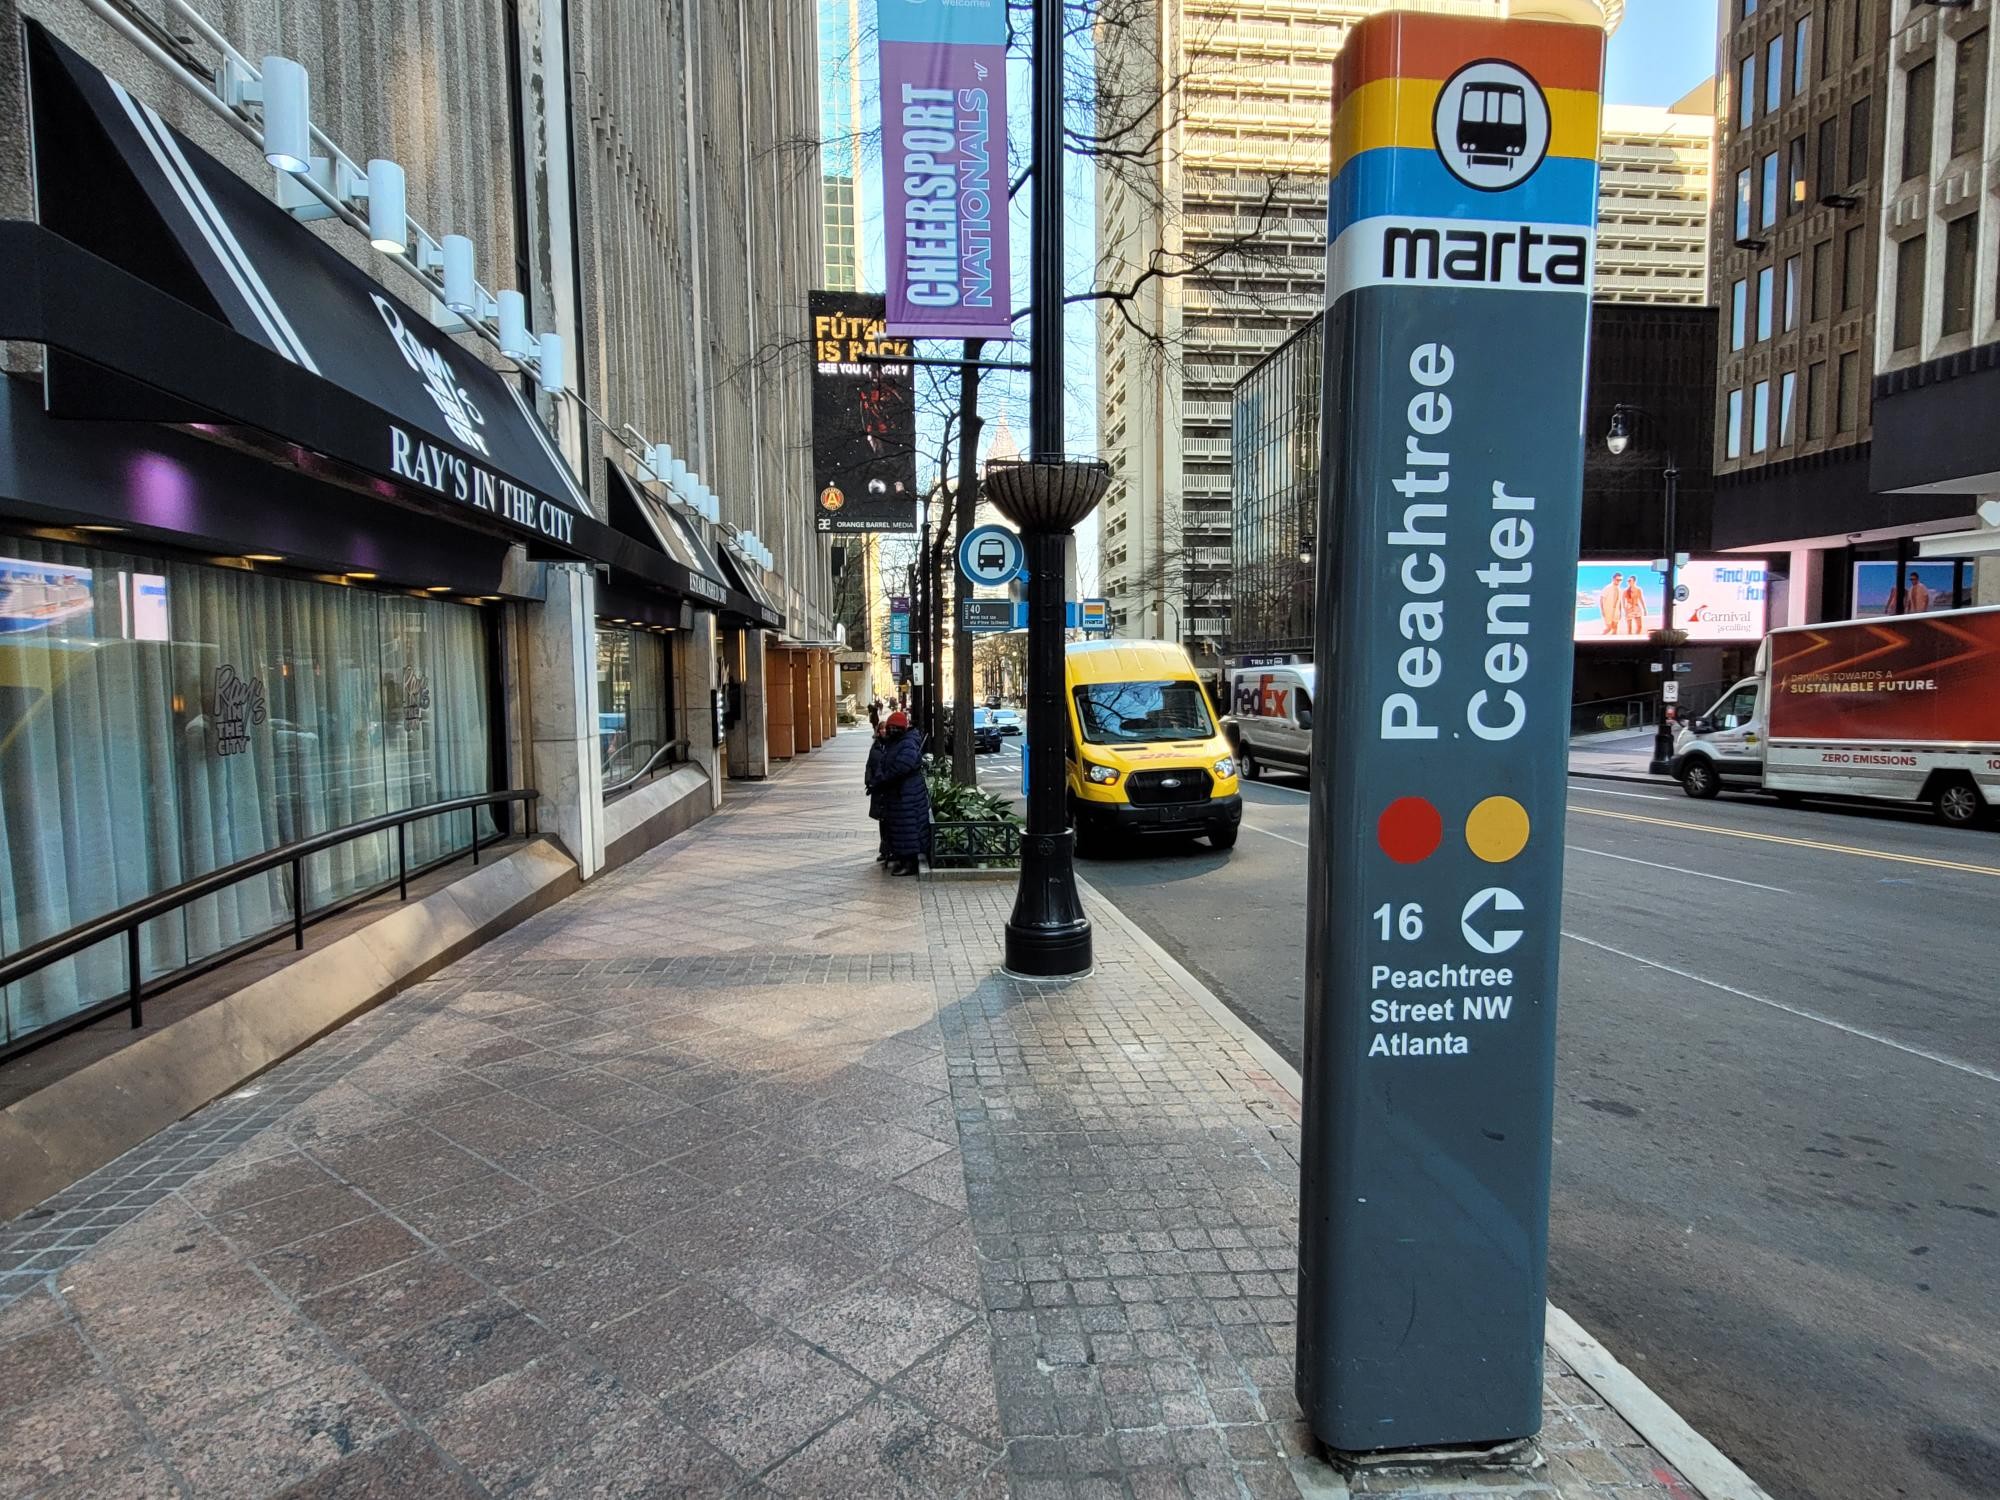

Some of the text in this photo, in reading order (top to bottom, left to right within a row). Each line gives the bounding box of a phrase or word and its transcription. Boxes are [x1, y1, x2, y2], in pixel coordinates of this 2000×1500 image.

[902, 83, 959, 308] CHEERSPORT
[958, 88, 993, 307] NATIONALS
[1382, 226, 1587, 285] marta
[818, 341, 908, 361] IS BACK
[818, 363, 908, 376] SEE YOU MCH 7
[390, 425, 574, 544] RAY'S IN THE CITY
[1380, 342, 1455, 740] Peachtree
[970, 604, 981, 614] 40
[1467, 480, 1536, 741] Center
[1702, 611, 1751, 622] Carnival
[1790, 679, 1938, 694] SUSTAINABLE FUTURE.
[1791, 670, 1893, 682] DRIVING TOWARDS A
[1234, 674, 1288, 718] FedEx
[1821, 753, 1850, 763] ZERO
[1853, 754, 1917, 766] EMISSIONS
[1373, 902, 1423, 941] 16
[1371, 964, 1513, 989] Peachtree
[1370, 996, 1513, 1023] Street NW
[1368, 1032, 1468, 1057] Atlanta
